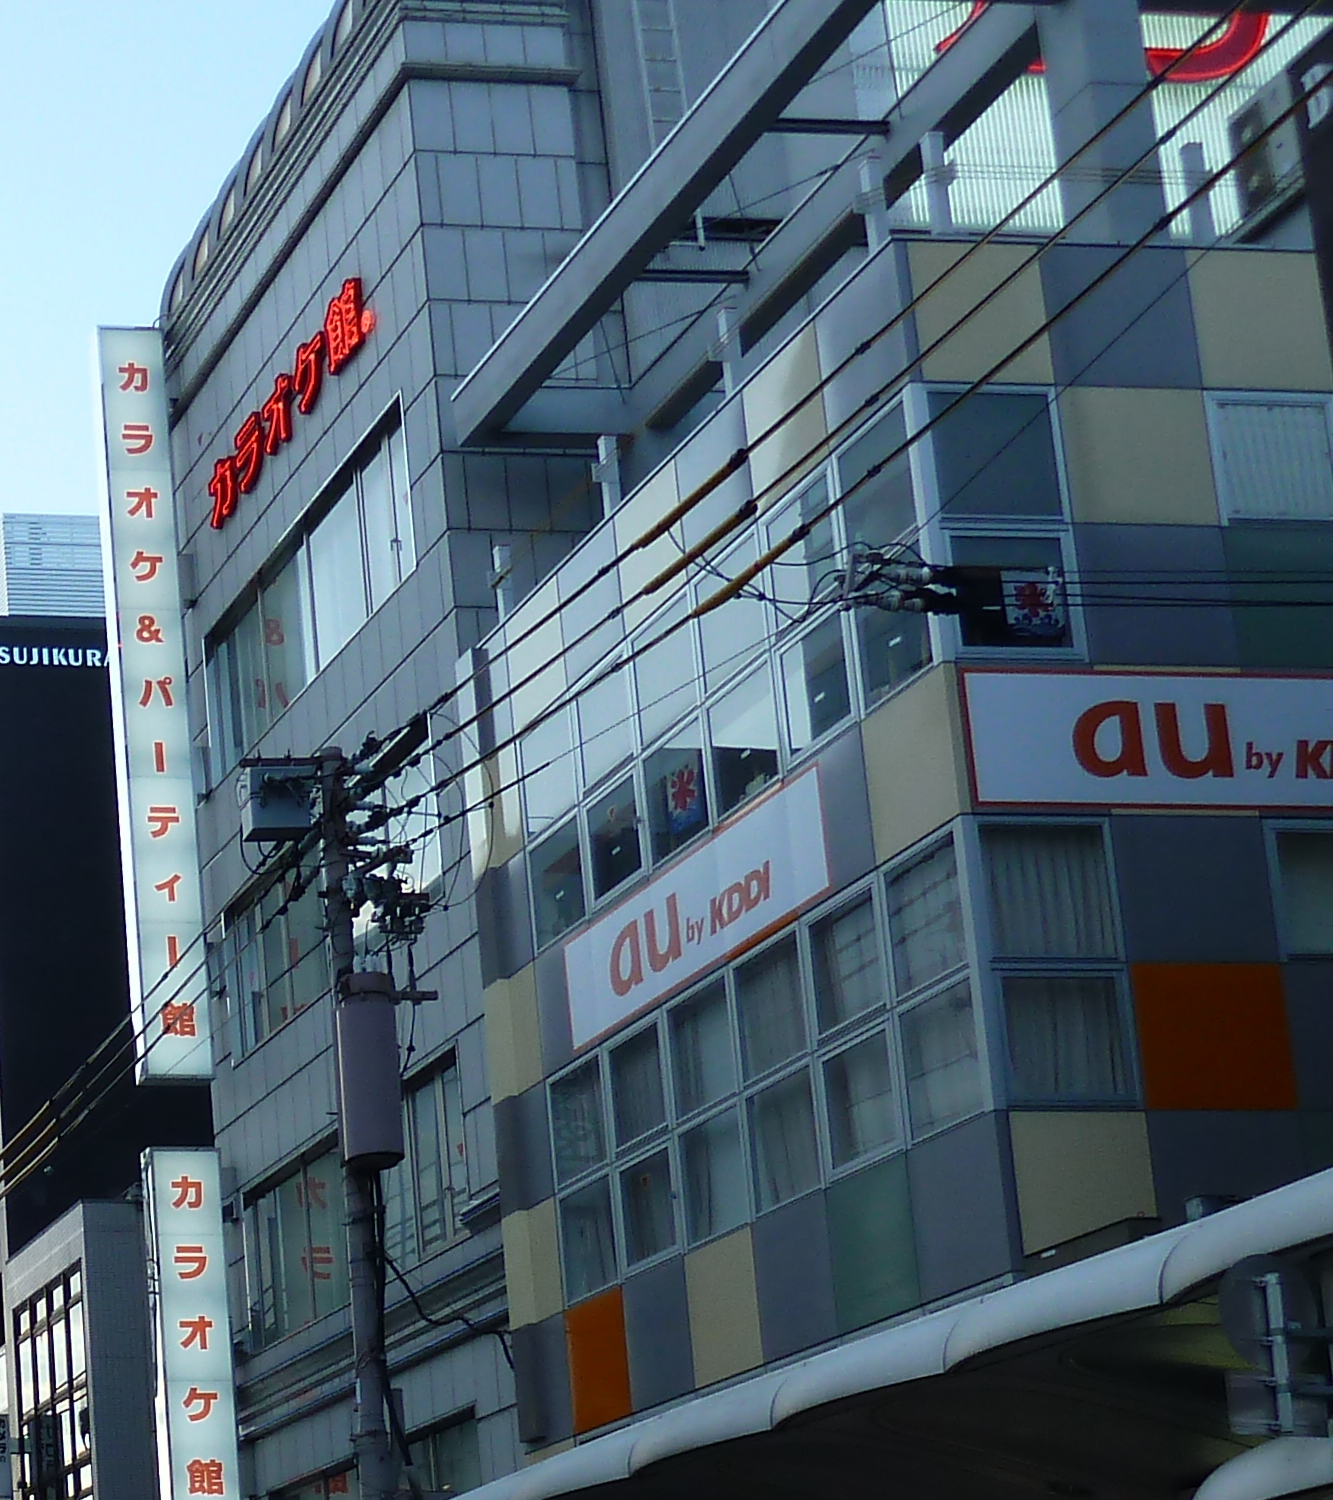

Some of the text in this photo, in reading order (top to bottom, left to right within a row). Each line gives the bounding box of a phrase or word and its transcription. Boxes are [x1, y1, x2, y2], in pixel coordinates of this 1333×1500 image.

[207, 277, 367, 529] カラオケ館
[117, 361, 199, 1039] カラオケ&パーティー館
[1071, 699, 1333, 779] au by K
[609, 861, 772, 997] au by KDDI
[169, 1173, 227, 1497] カラオケ館
